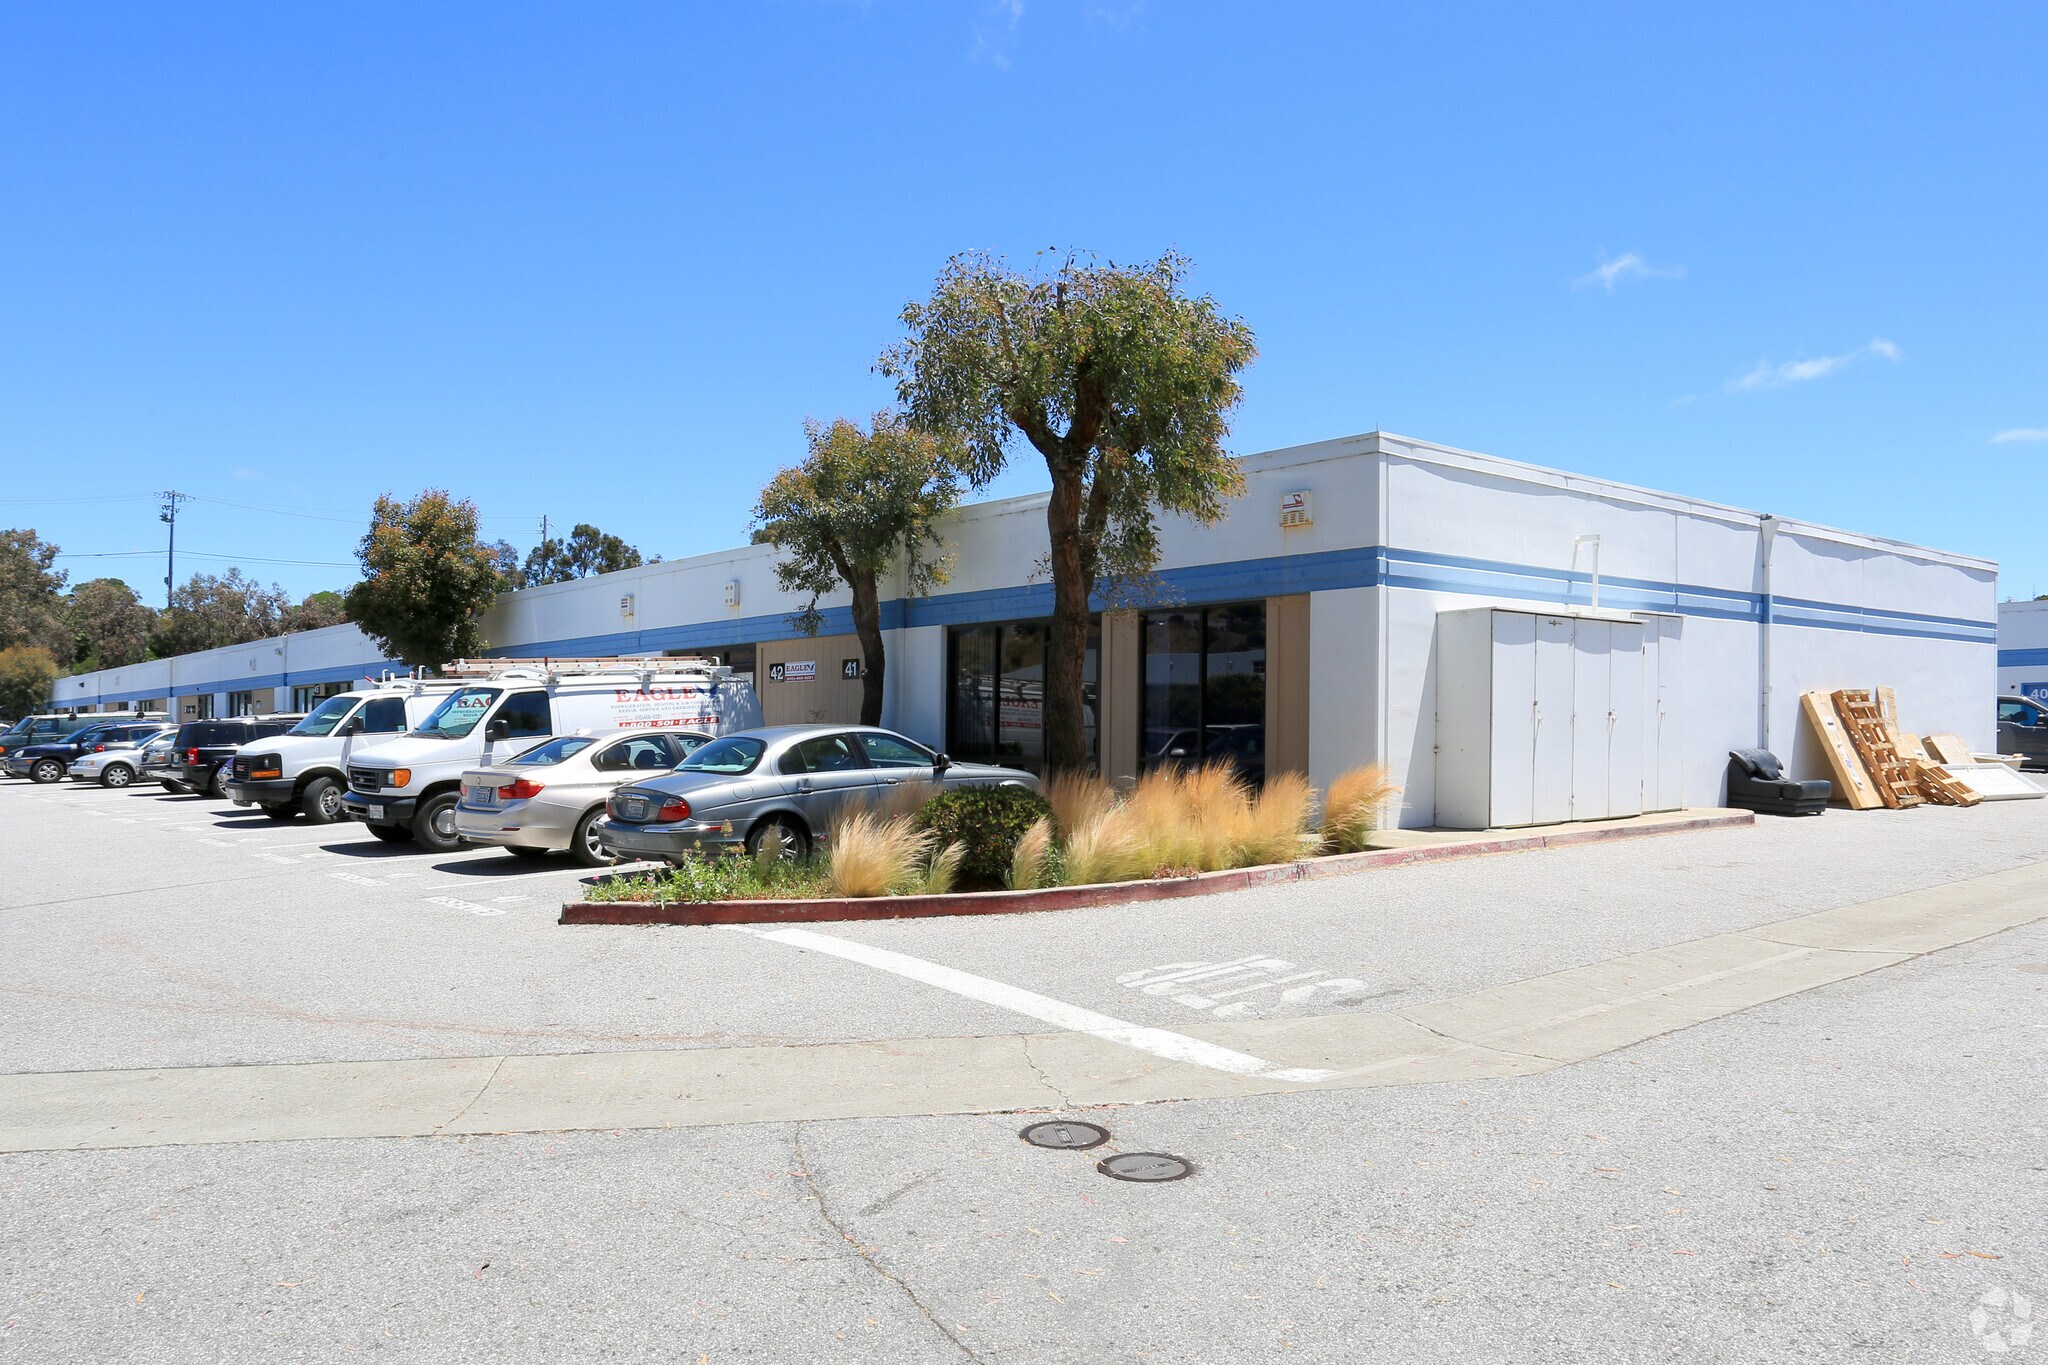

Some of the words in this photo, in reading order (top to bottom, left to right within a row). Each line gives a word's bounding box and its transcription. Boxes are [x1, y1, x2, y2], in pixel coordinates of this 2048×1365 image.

[771, 666, 783, 680] 42
[786, 664, 808, 672] EAGLE
[845, 661, 857, 677] 41
[614, 686, 697, 703] EAGLE
